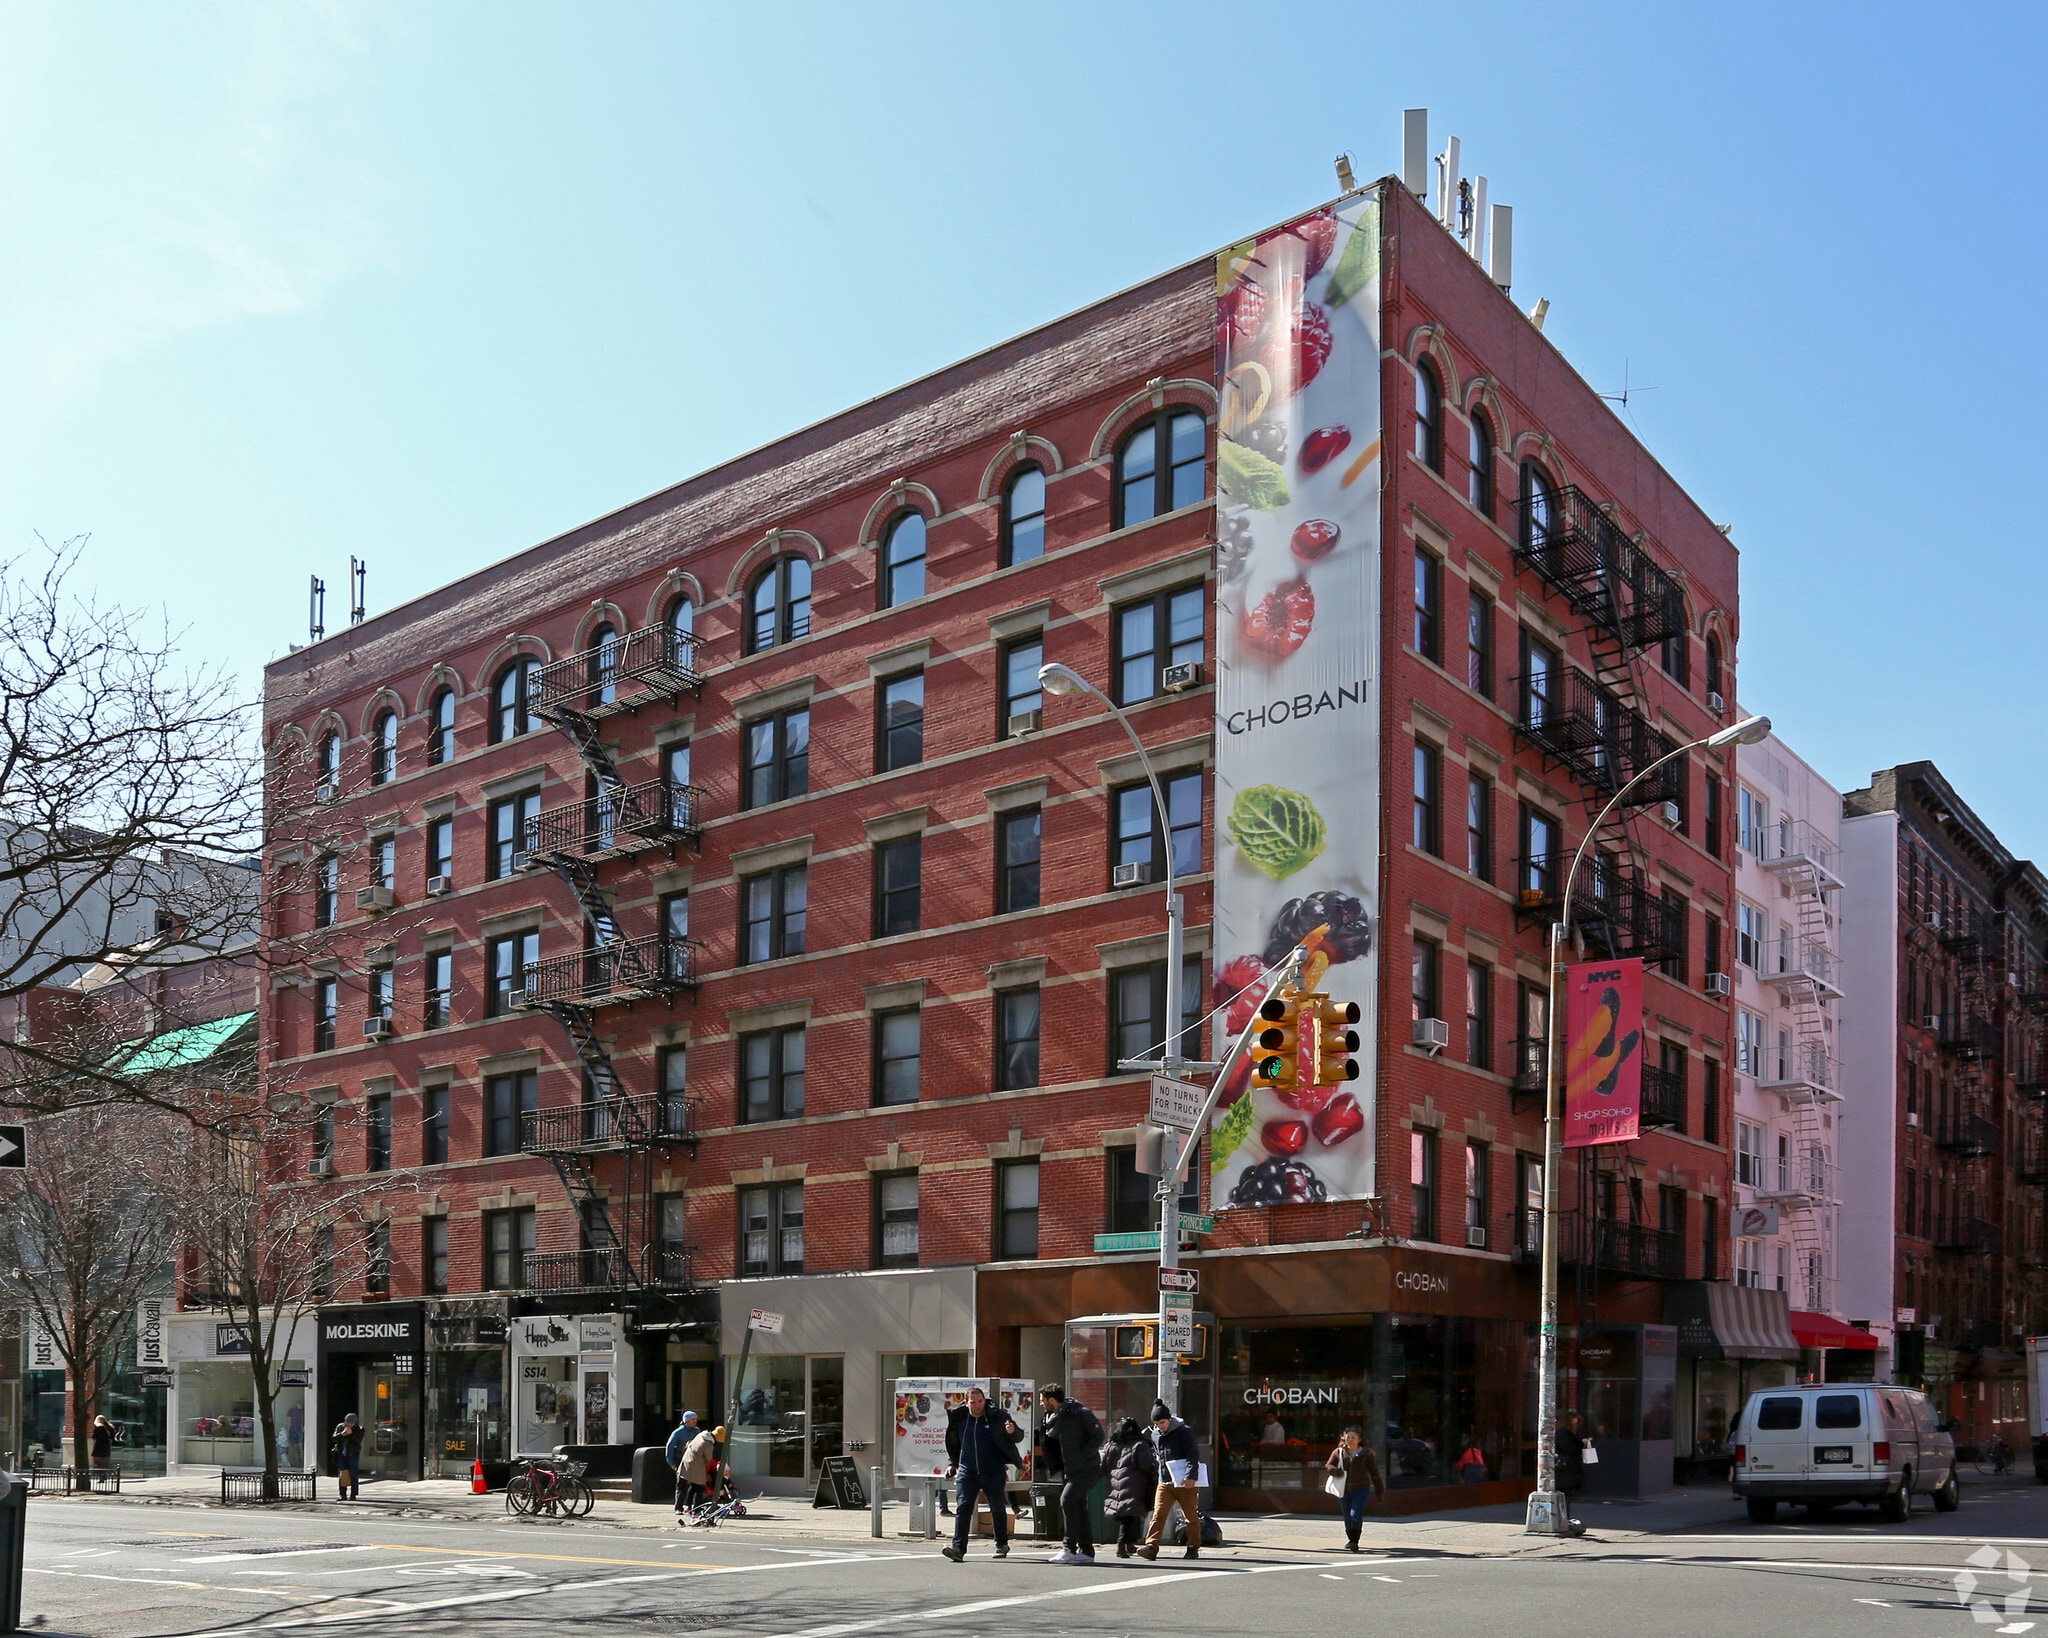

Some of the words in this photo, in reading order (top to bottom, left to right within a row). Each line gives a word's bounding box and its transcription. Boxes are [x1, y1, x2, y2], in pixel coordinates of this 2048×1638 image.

[1227, 679, 1367, 735] CHOBANI
[1587, 969, 1622, 984] NYC
[1160, 1085, 1170, 1096] NO
[1173, 1088, 1199, 1104] TURNS
[1155, 1097, 1170, 1110] FOR
[1173, 1101, 1203, 1117] TRUCKS
[1573, 1110, 1601, 1121] SHOP
[1602, 1106, 1632, 1118] SOHO
[1588, 1118, 1636, 1138] melissa
[1179, 1214, 1204, 1231] PRINCE
[1204, 1218, 1211, 1226] ST
[1106, 1235, 1161, 1249] BROADWAY
[1164, 1274, 1177, 1285] ONE
[1181, 1275, 1194, 1286] WAY
[1396, 1271, 1449, 1293] CHOBANI
[752, 1310, 762, 1319] NO
[326, 1323, 410, 1339] MOLESKINE
[525, 1323, 549, 1348] Happy
[1167, 1326, 1191, 1337] SHARED
[1170, 1339, 1187, 1348] LANE
[1243, 1387, 1338, 1404] CHOBANI
[445, 1440, 466, 1451] SALE
